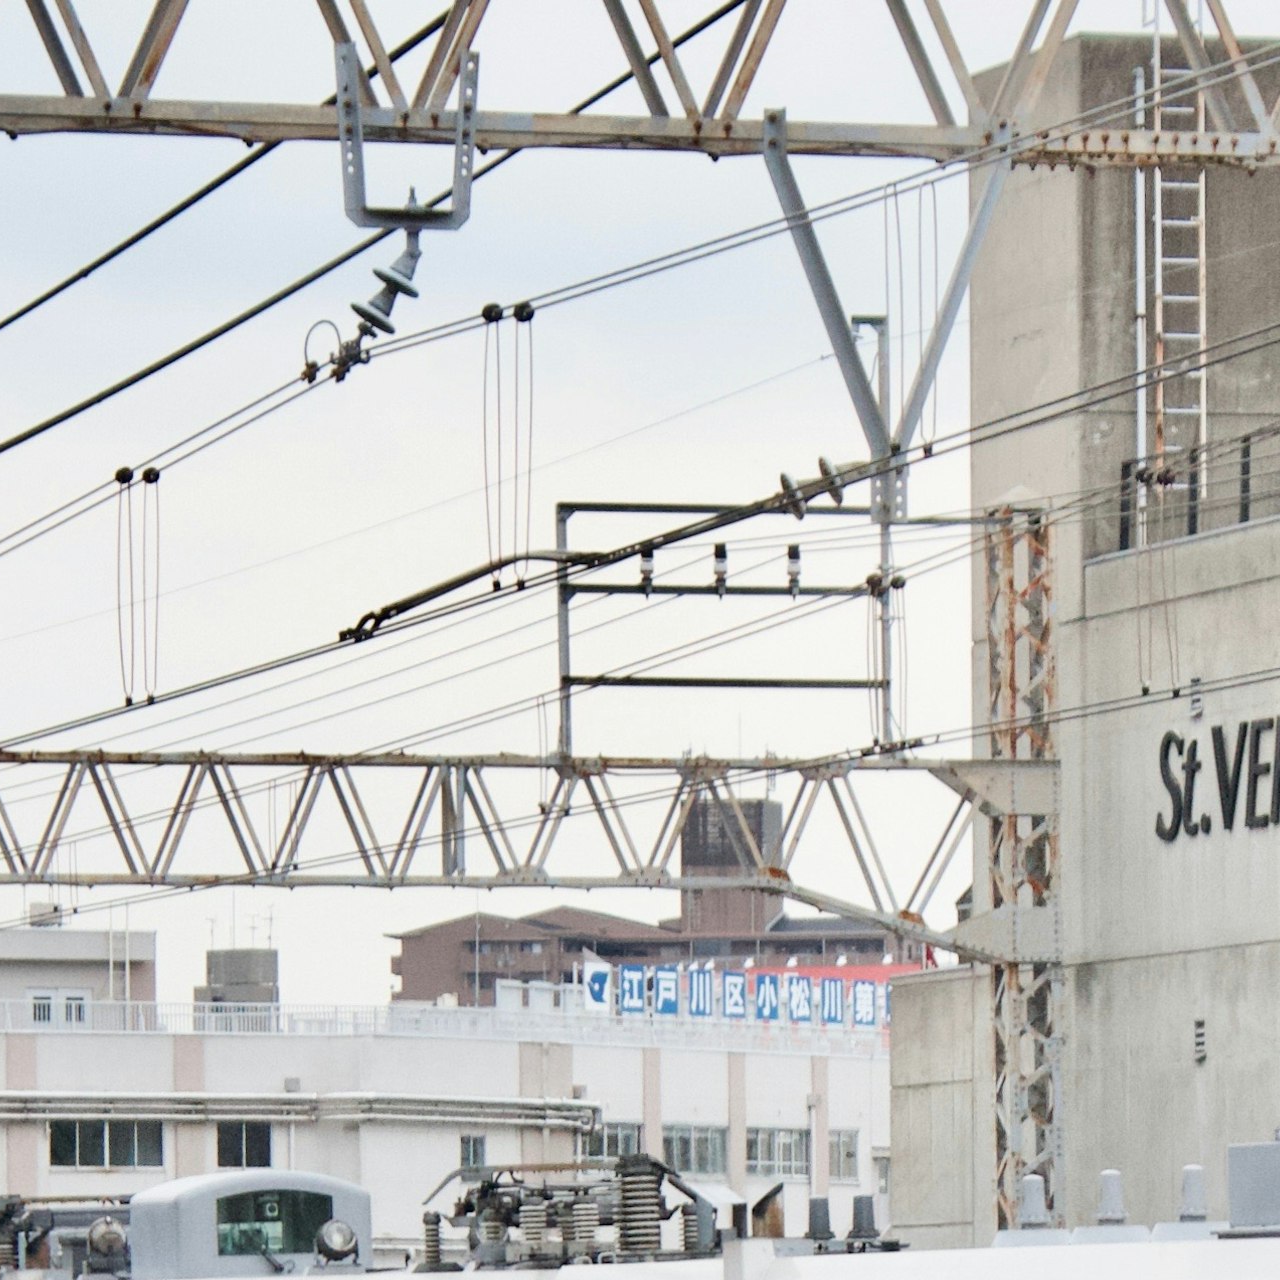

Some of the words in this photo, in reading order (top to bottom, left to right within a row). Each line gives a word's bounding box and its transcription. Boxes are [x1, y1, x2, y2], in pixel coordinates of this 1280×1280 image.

[623, 968, 891, 1024] 江戸川区小松川第
